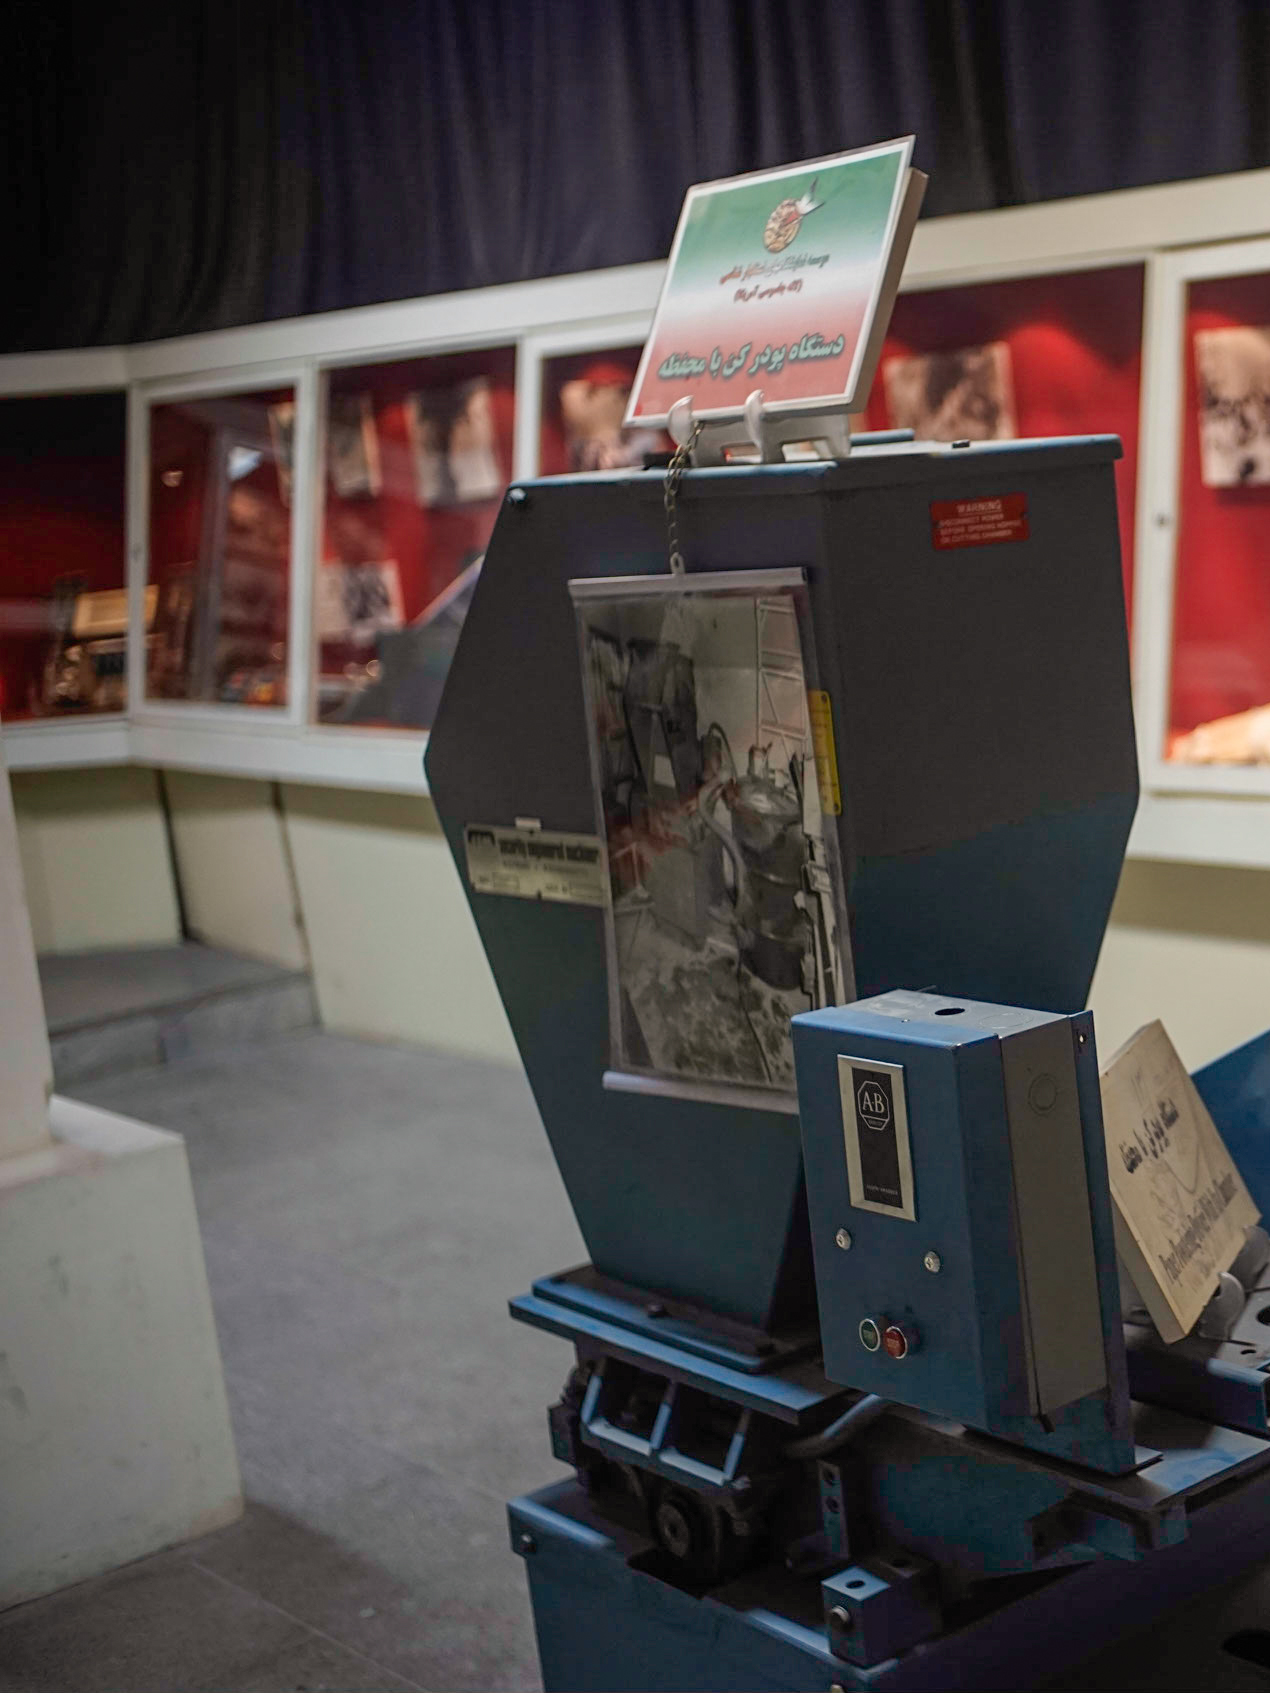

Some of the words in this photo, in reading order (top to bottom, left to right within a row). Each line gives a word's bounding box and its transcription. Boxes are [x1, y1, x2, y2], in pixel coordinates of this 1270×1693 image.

[722, 343, 752, 378] کن
[748, 342, 789, 372] پودر
[789, 331, 846, 361] دستگاه
[657, 350, 706, 379] محفظه
[708, 346, 723, 377] با
